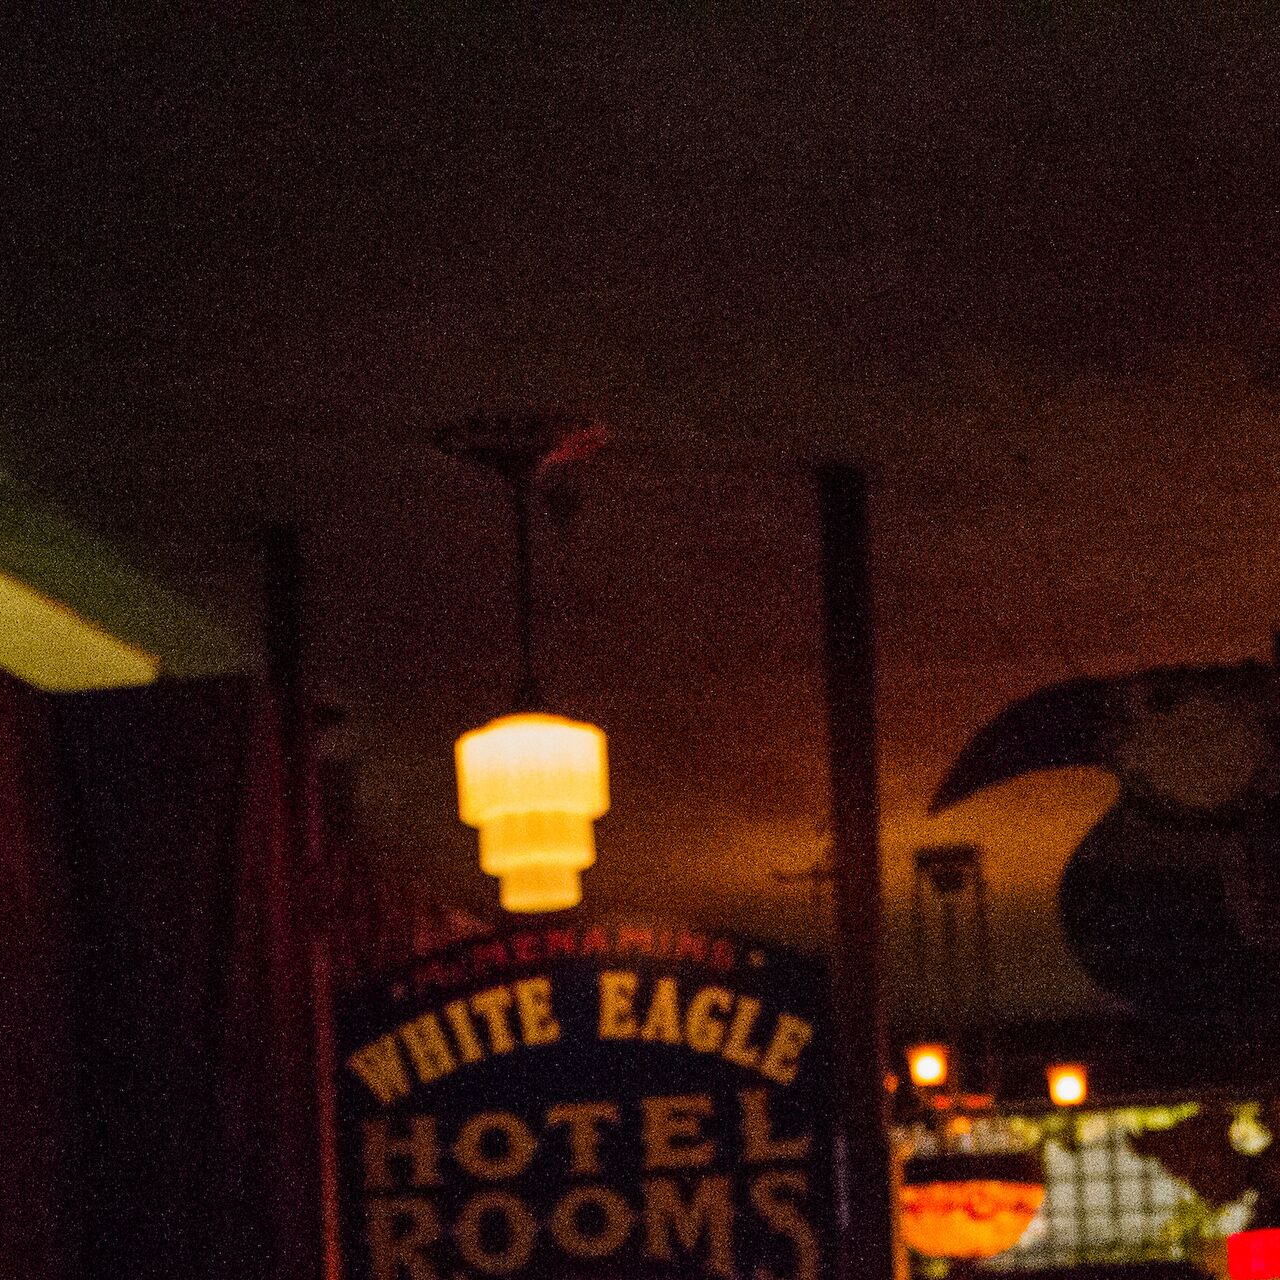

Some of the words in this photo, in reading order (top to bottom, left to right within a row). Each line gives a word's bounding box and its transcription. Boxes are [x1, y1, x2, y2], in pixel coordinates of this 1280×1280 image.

[347, 975, 561, 1104] WHITE
[597, 970, 815, 1087] EAGLE
[361, 1087, 812, 1189] HOTEL
